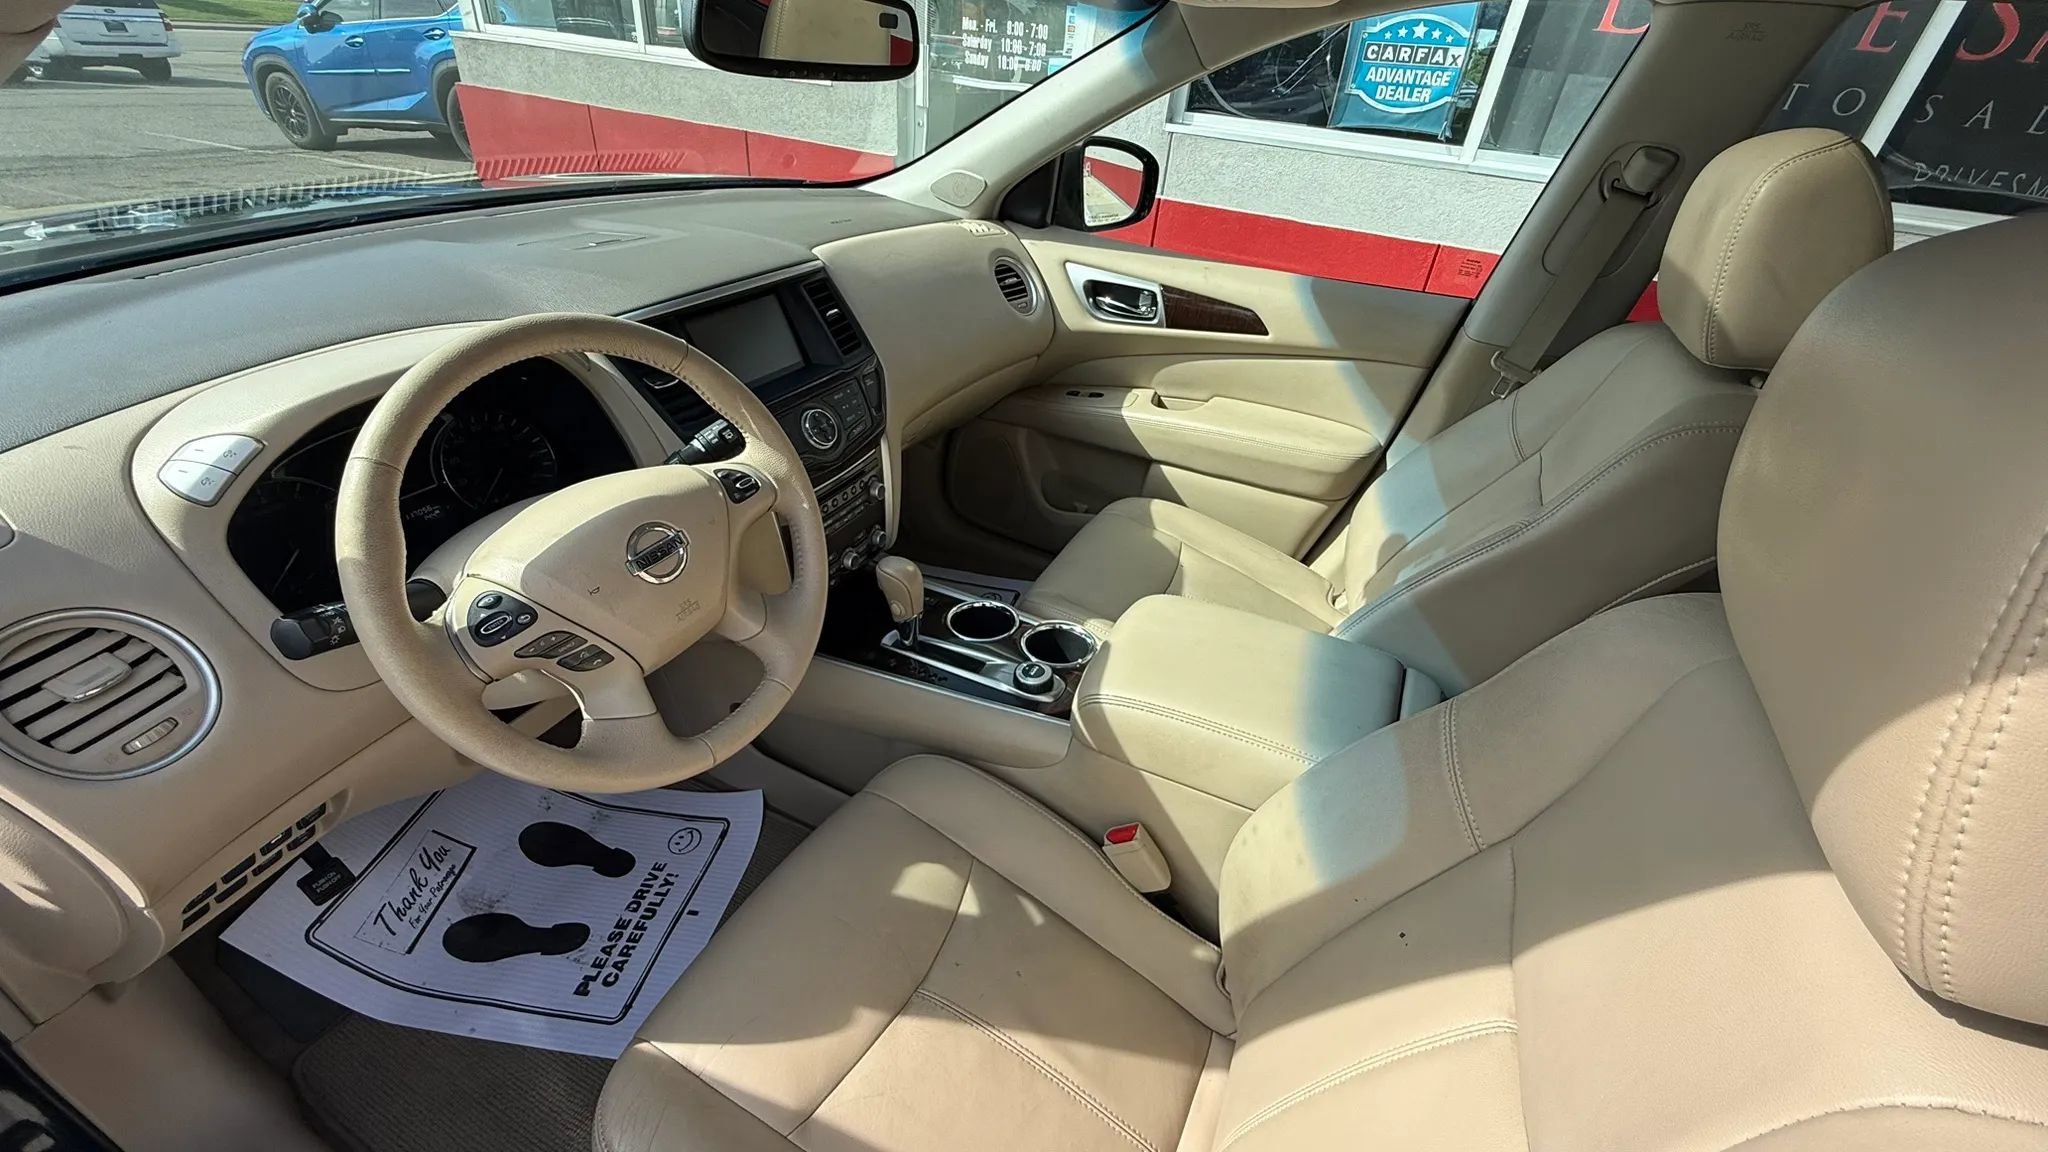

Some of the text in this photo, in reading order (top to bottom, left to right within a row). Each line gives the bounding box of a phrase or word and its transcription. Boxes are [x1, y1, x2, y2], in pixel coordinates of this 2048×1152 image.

[985, 18, 998, 33] Fri.
[1030, 23, 1048, 40] 7:00
[962, 33, 992, 52] Saturday
[1029, 41, 1046, 57] 7:00
[1365, 43, 1463, 67] CARFAX
[965, 50, 989, 69] Sunday
[1365, 66, 1452, 87] ADVANTAGE
[1375, 85, 1432, 103] DEALER
[635, 532, 684, 571] NISSAN
[373, 846, 450, 936] Thank You
[573, 861, 668, 997] PLEASE DRIVE
[601, 872, 680, 988] CAREFULLY!
